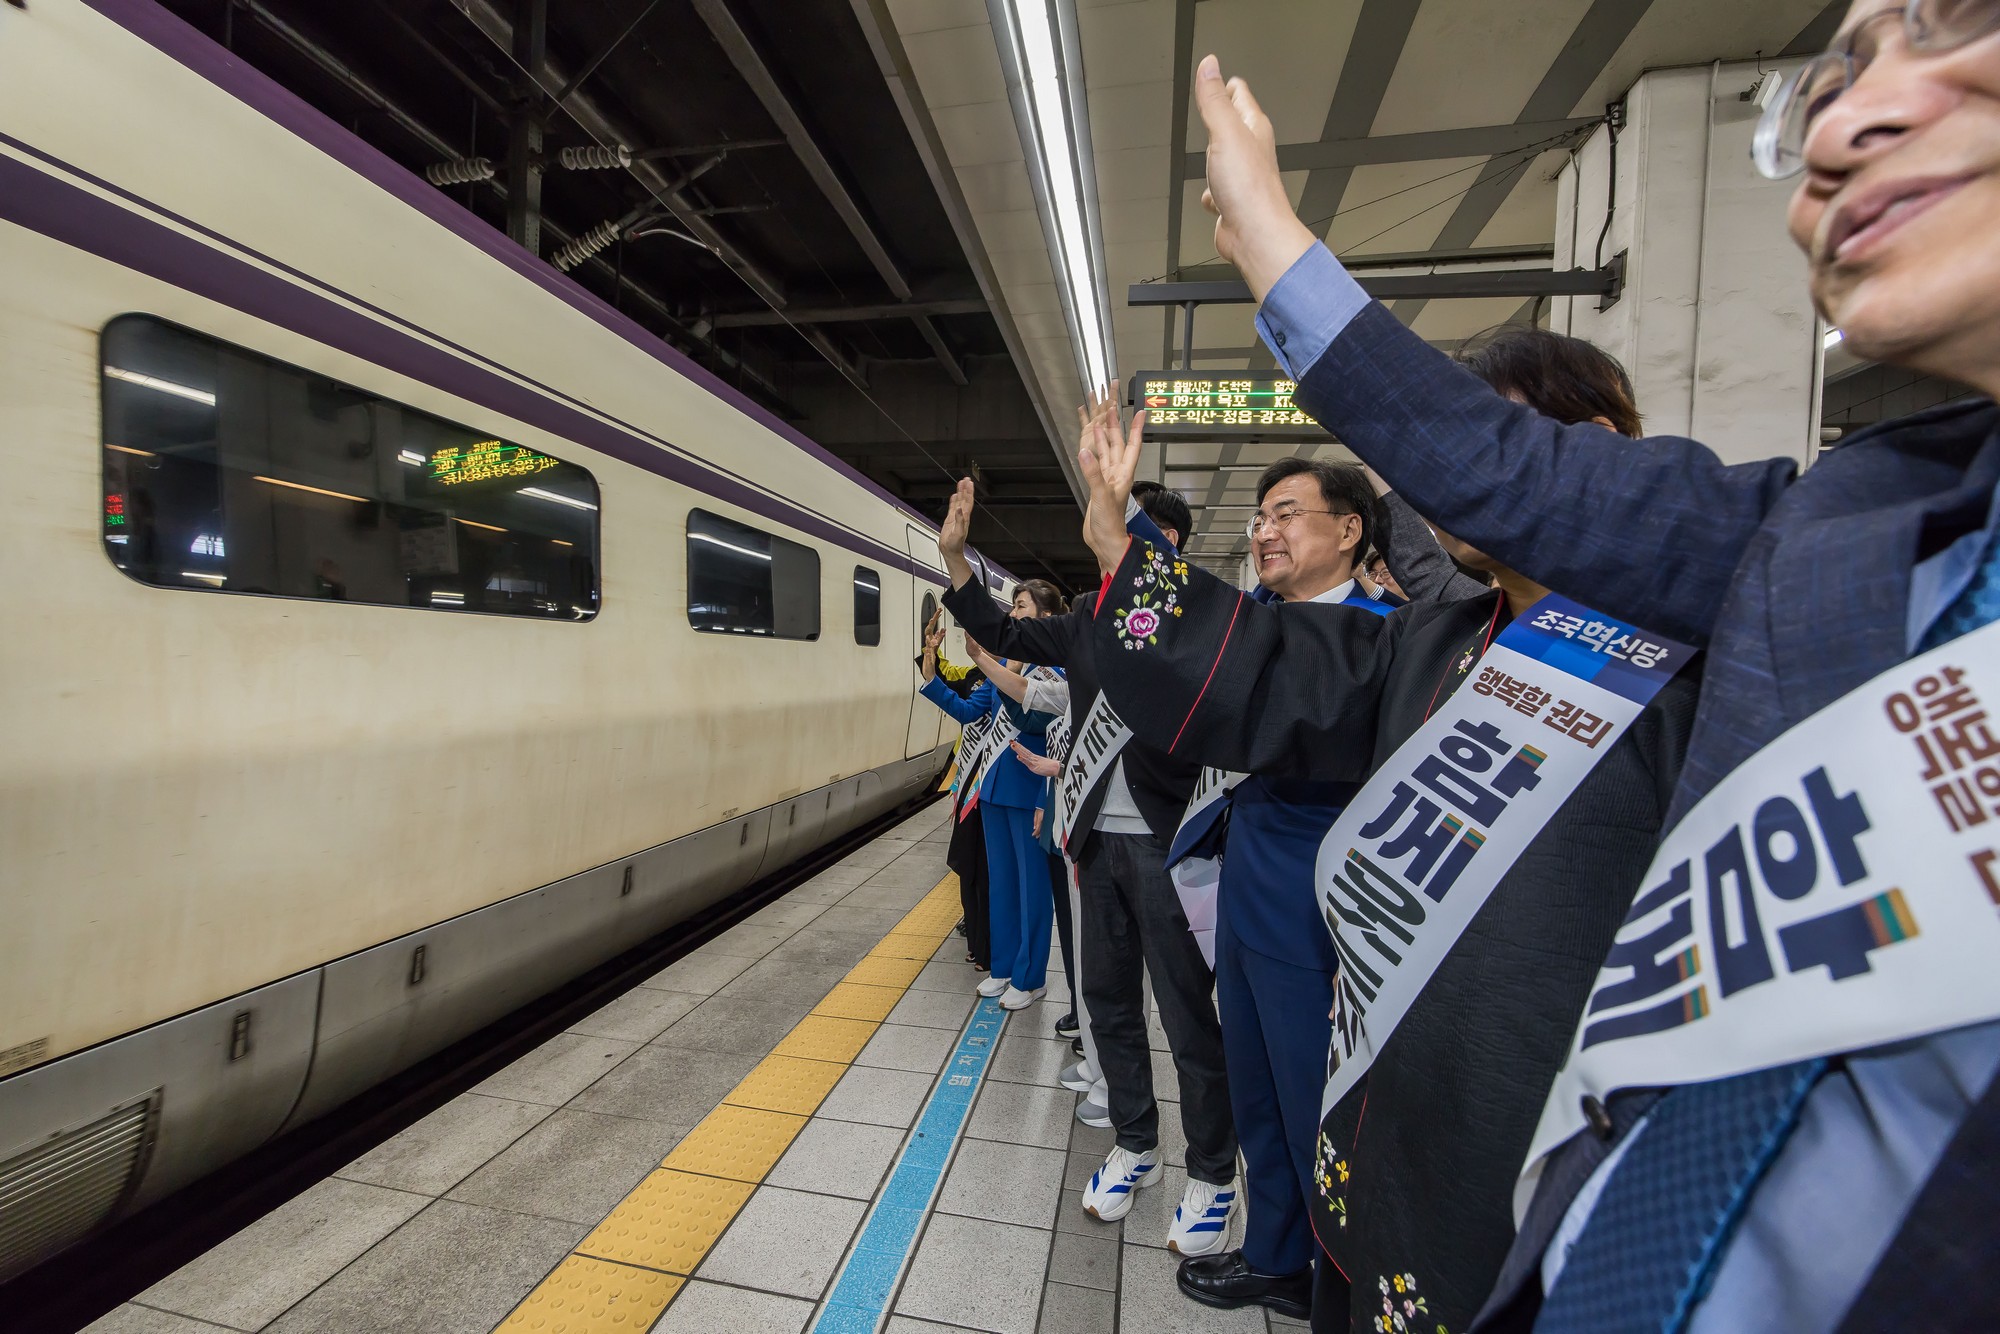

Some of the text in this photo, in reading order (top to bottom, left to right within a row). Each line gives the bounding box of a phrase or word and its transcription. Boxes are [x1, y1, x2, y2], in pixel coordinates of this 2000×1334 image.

[1146, 381, 1168, 393] 방향
[1173, 381, 1212, 393] 출발시간
[1218, 381, 1251, 393] 도착역
[1172, 395, 1210, 407] 09:44
[1217, 394, 1247, 407] 목포
[1531, 609, 1669, 670] 조국혁신당
[1472, 665, 1615, 749] 행복할 권리
[1358, 717, 1548, 904] 함께
[1579, 765, 1921, 1054] 함께
